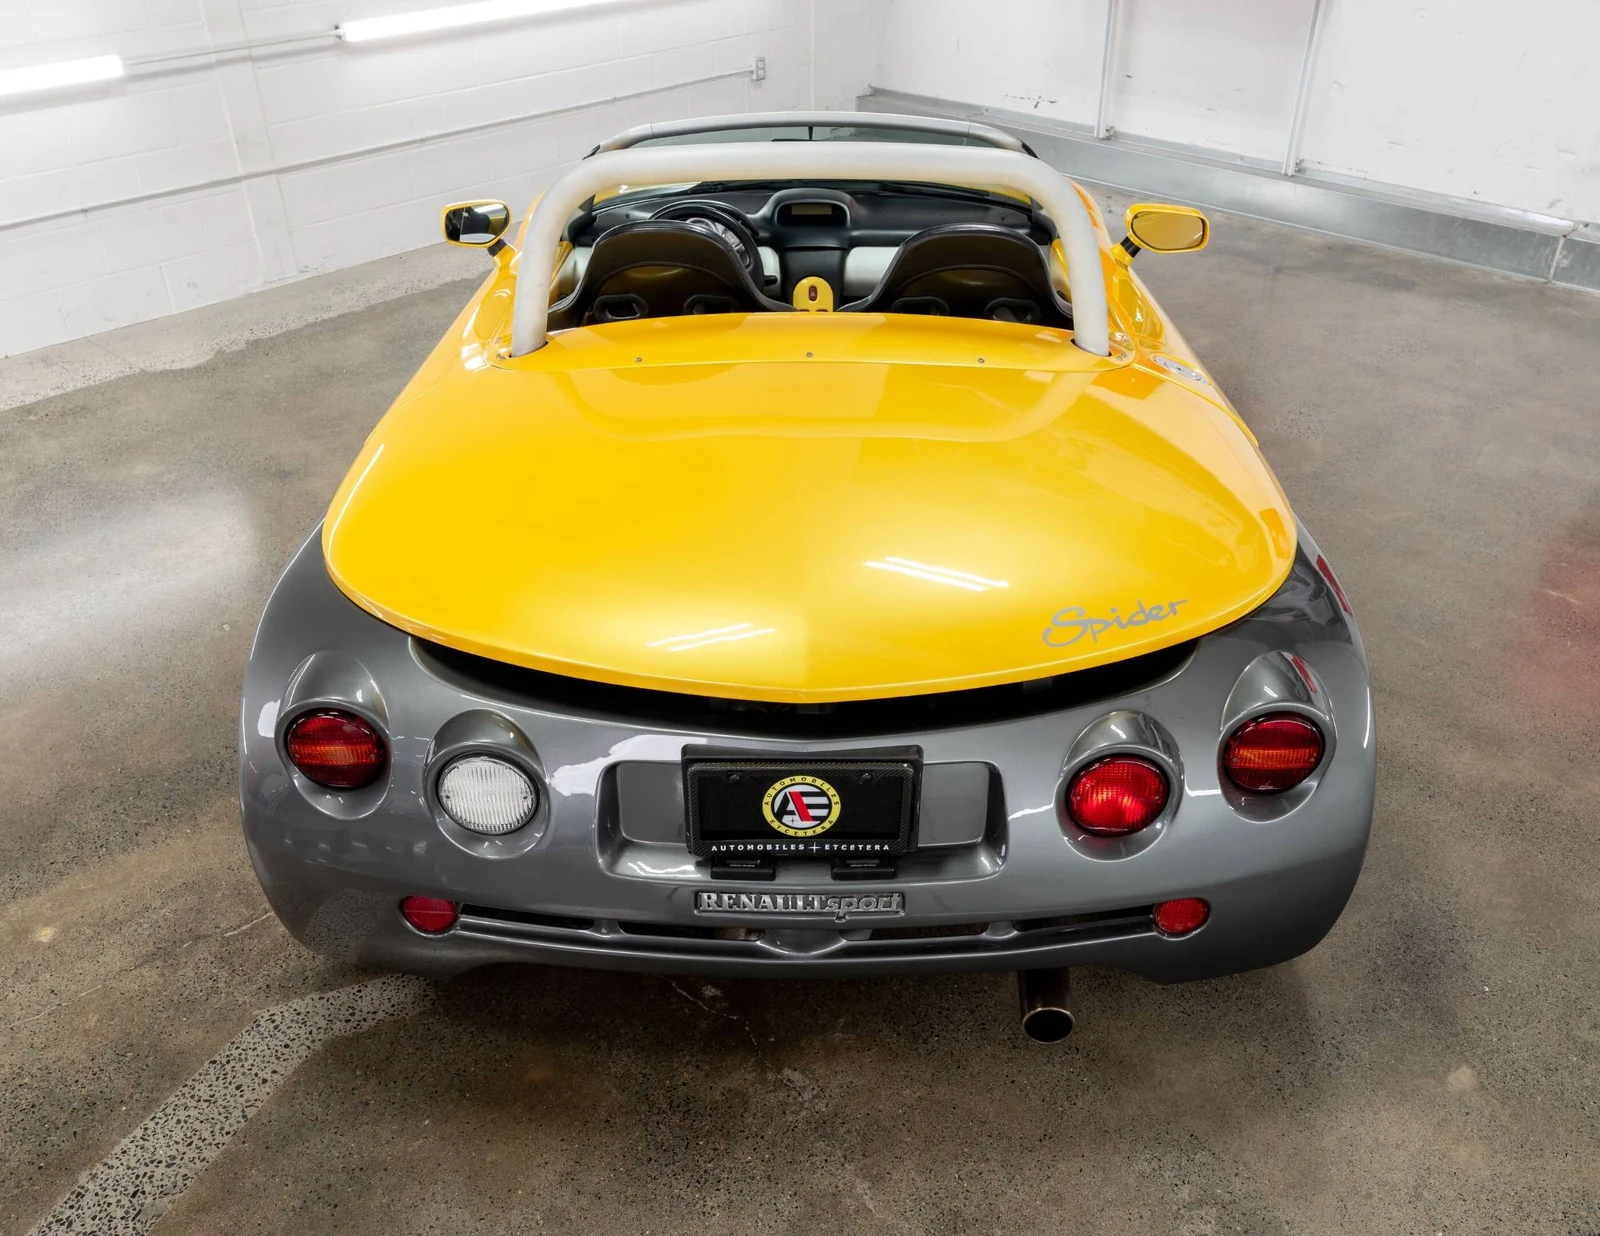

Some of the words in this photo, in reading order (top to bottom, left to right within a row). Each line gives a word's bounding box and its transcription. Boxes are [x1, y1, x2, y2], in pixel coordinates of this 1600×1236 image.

[1042, 599, 1188, 648] Spider
[764, 777, 839, 806] AUTOMOBILES
[769, 819, 834, 836] ETCETERA
